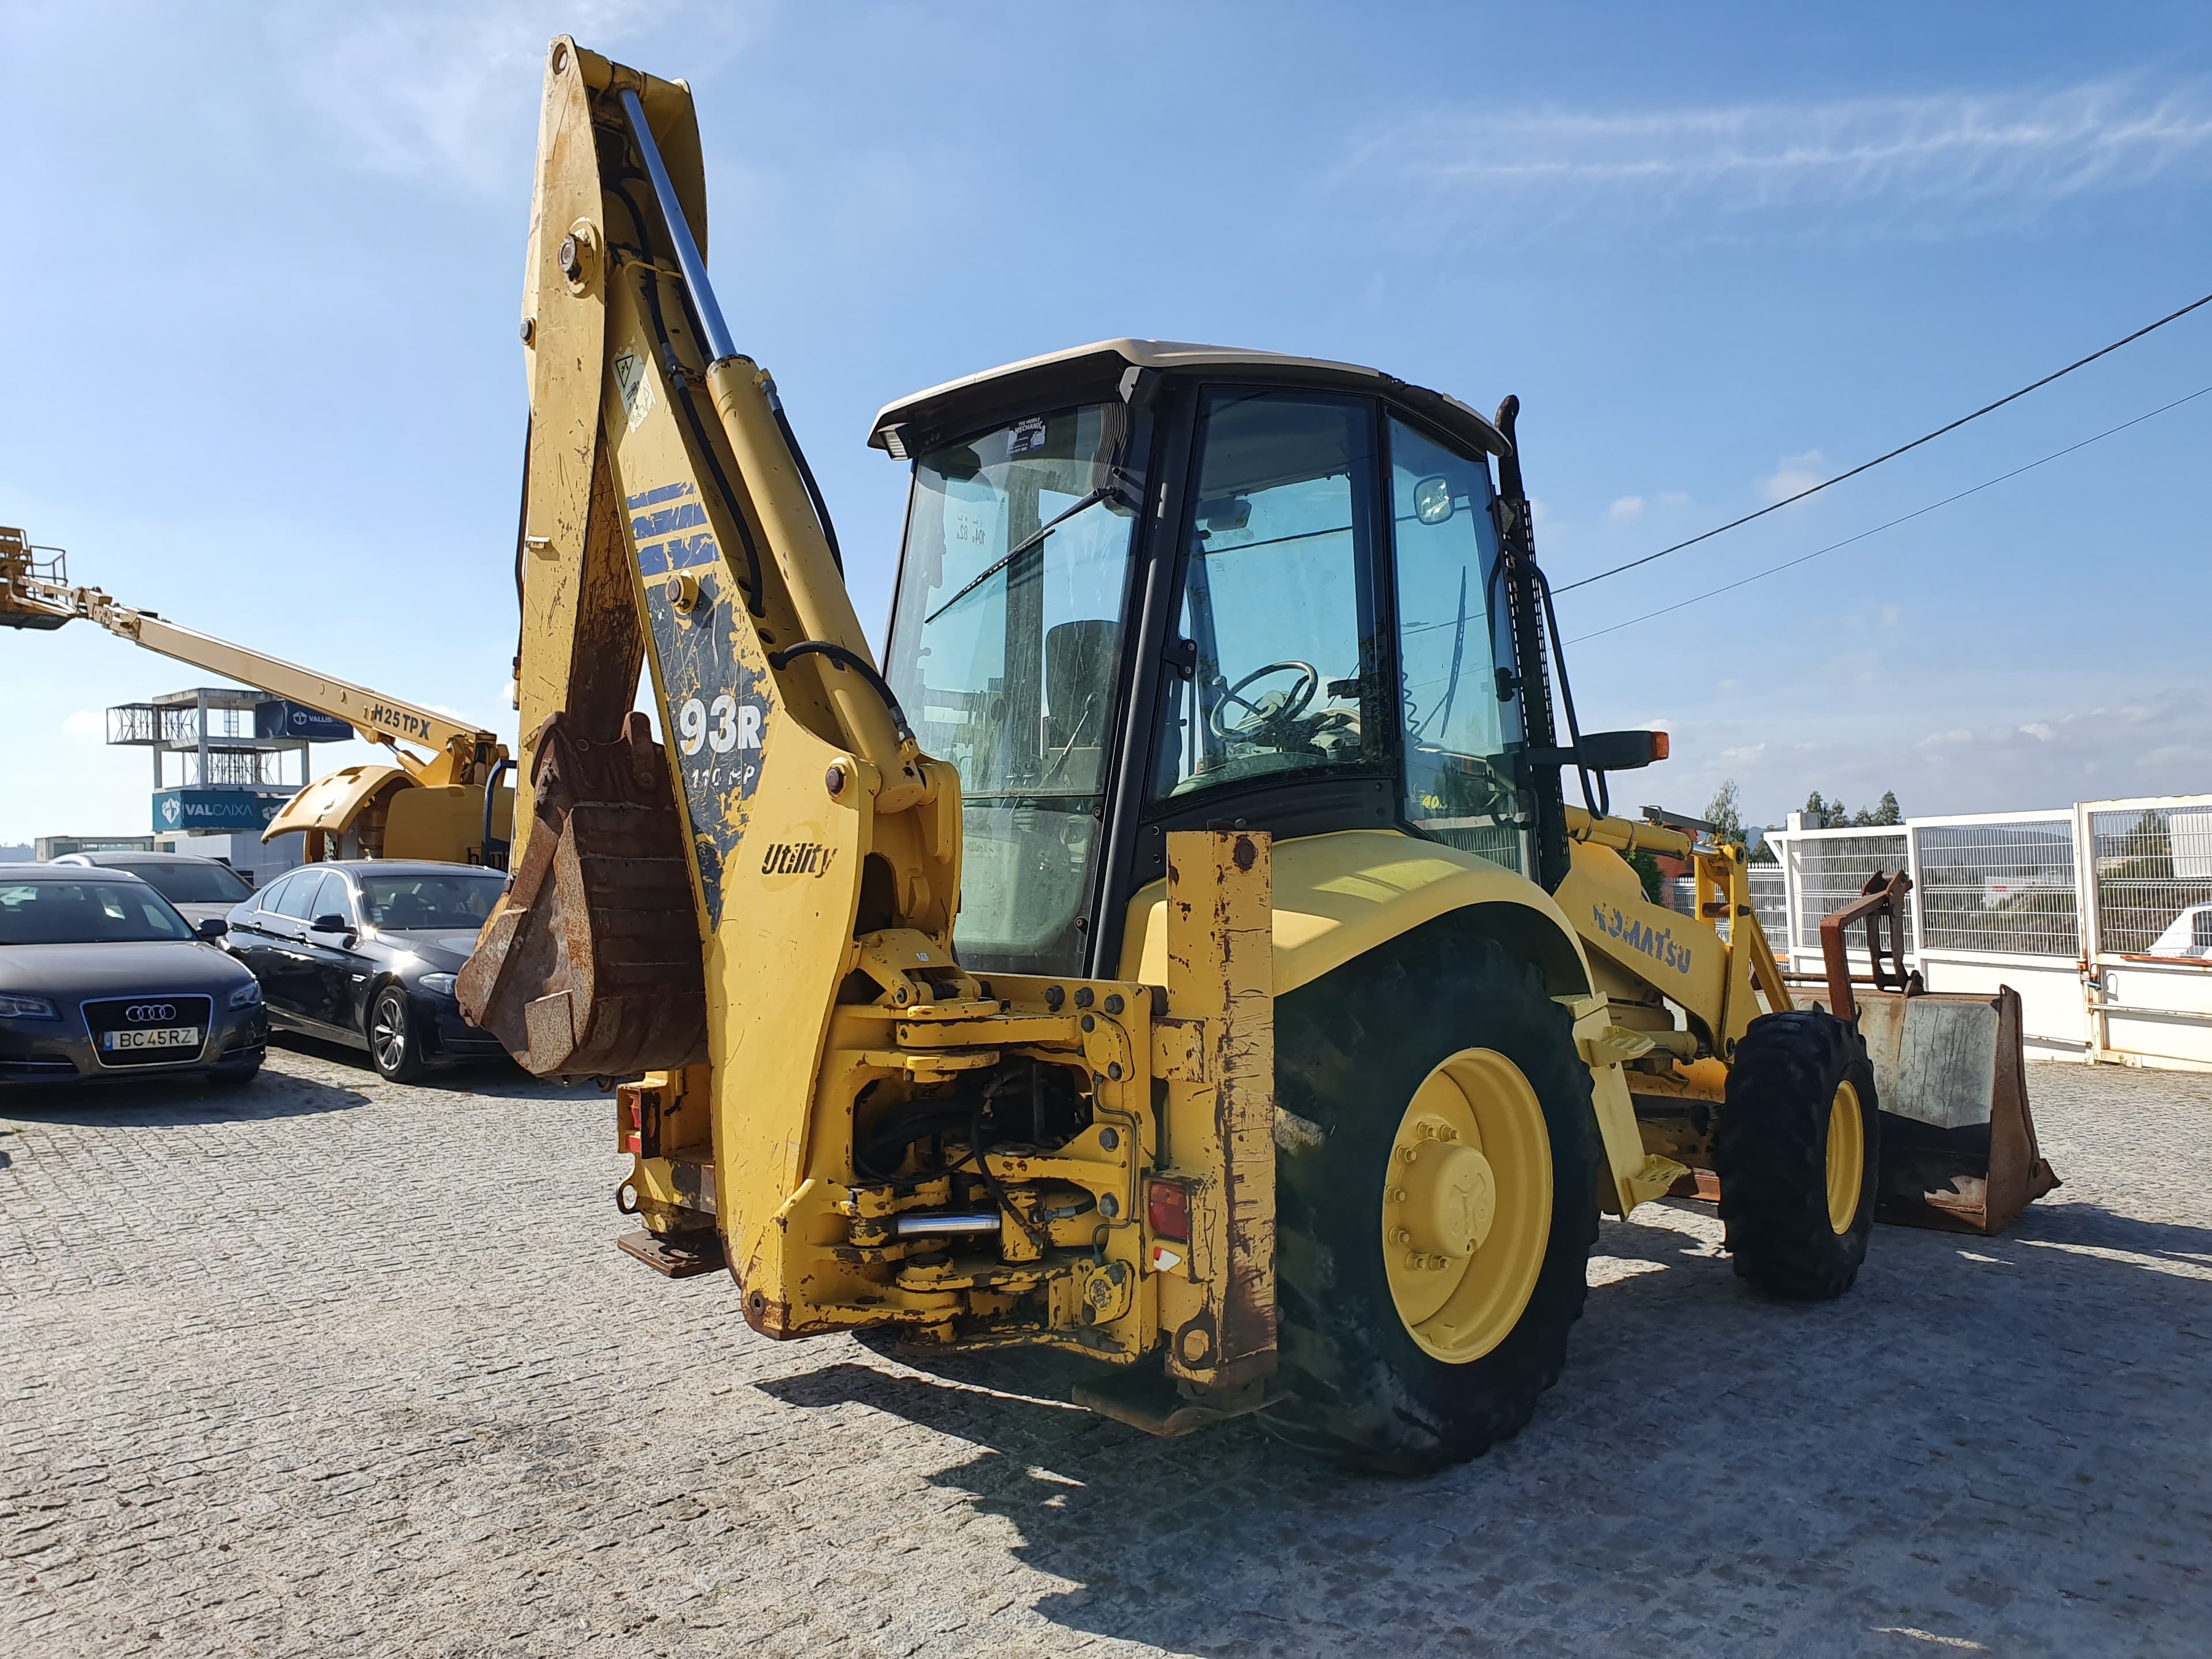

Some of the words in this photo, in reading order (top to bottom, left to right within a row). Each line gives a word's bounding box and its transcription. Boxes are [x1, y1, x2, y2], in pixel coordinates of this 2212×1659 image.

[1015, 421, 1043, 434] MECHANIC
[374, 703, 431, 741] H25TPX
[680, 695, 762, 756] 93R
[185, 804, 253, 816] VALCAIXA
[762, 843, 838, 878] Utility
